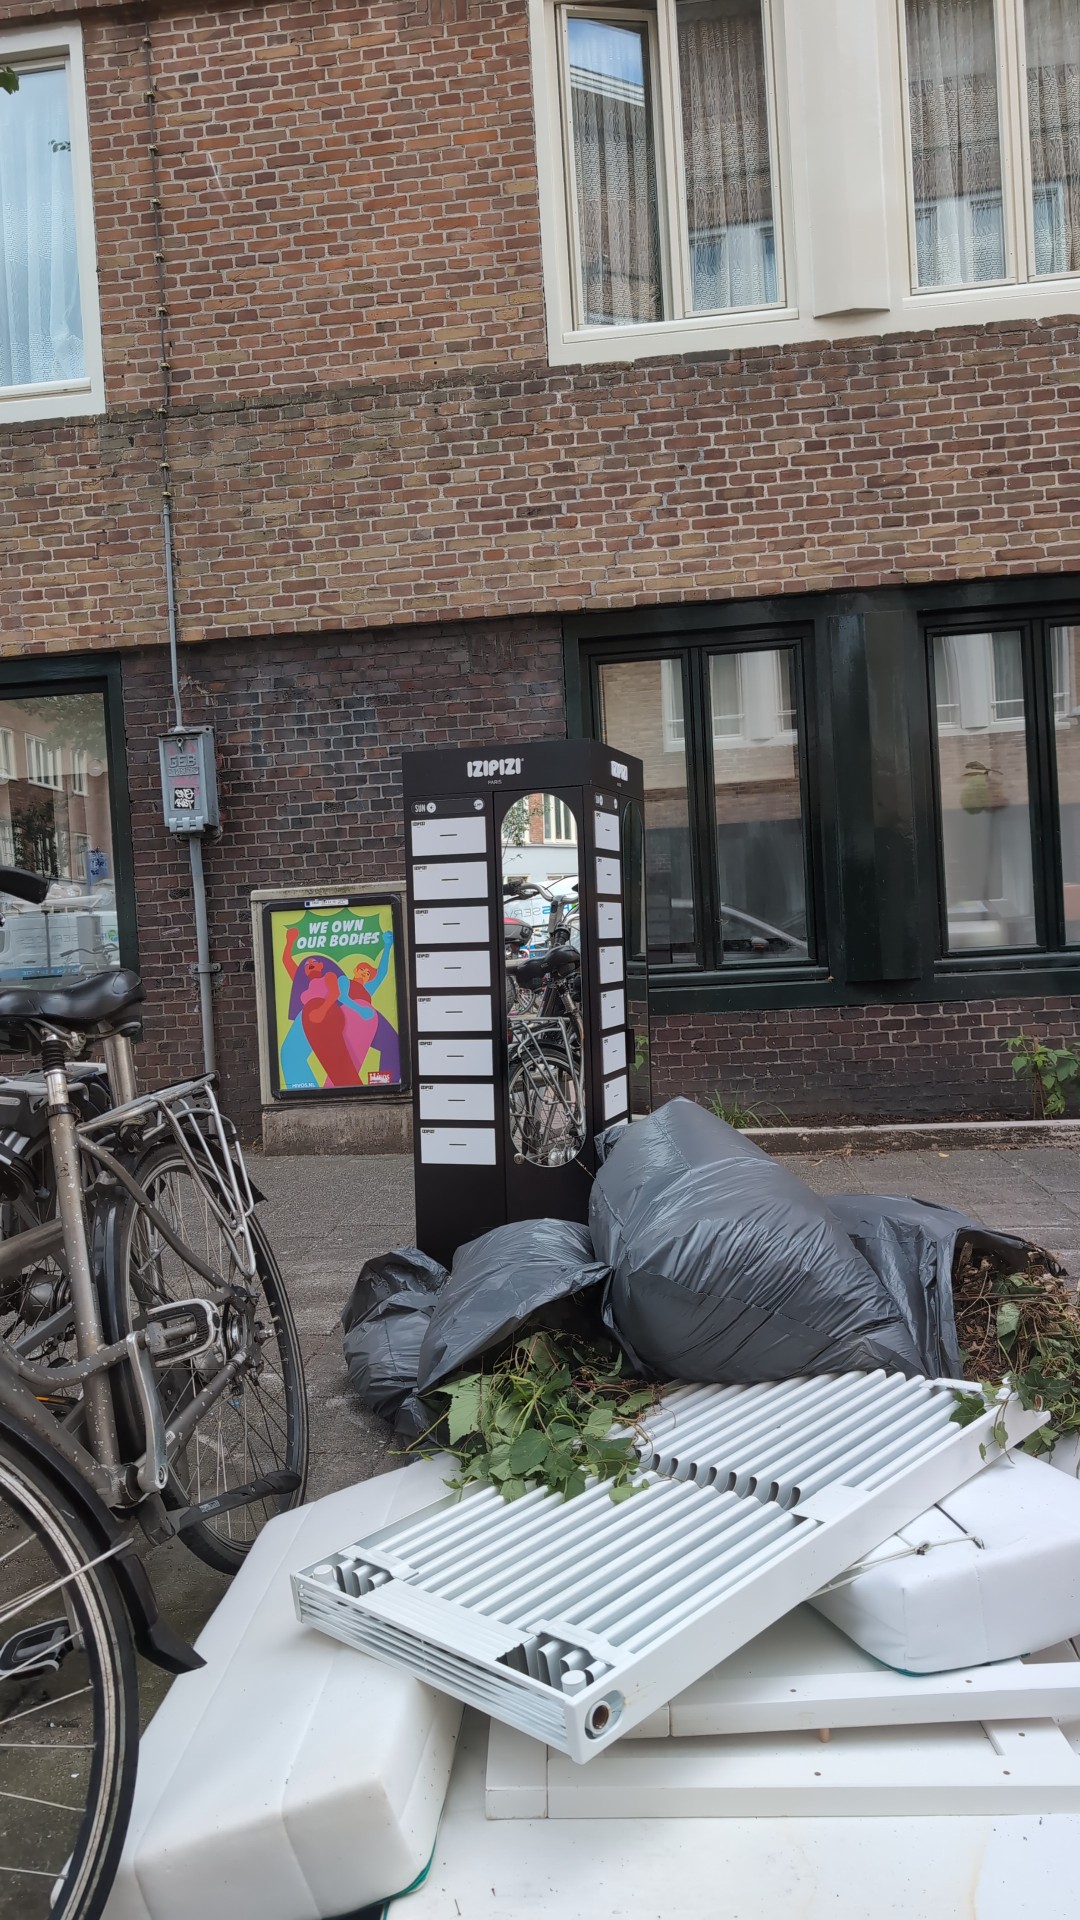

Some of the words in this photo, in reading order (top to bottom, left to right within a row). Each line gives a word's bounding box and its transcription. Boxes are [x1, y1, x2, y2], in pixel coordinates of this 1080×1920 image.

[169, 754, 196, 768] GEB
[467, 758, 522, 778] IZIPIZI
[414, 804, 426, 813] SUN
[309, 922, 328, 934] WE
[333, 919, 364, 933] OWN
[296, 936, 326, 949] OUR
[329, 931, 380, 948] BODIES
